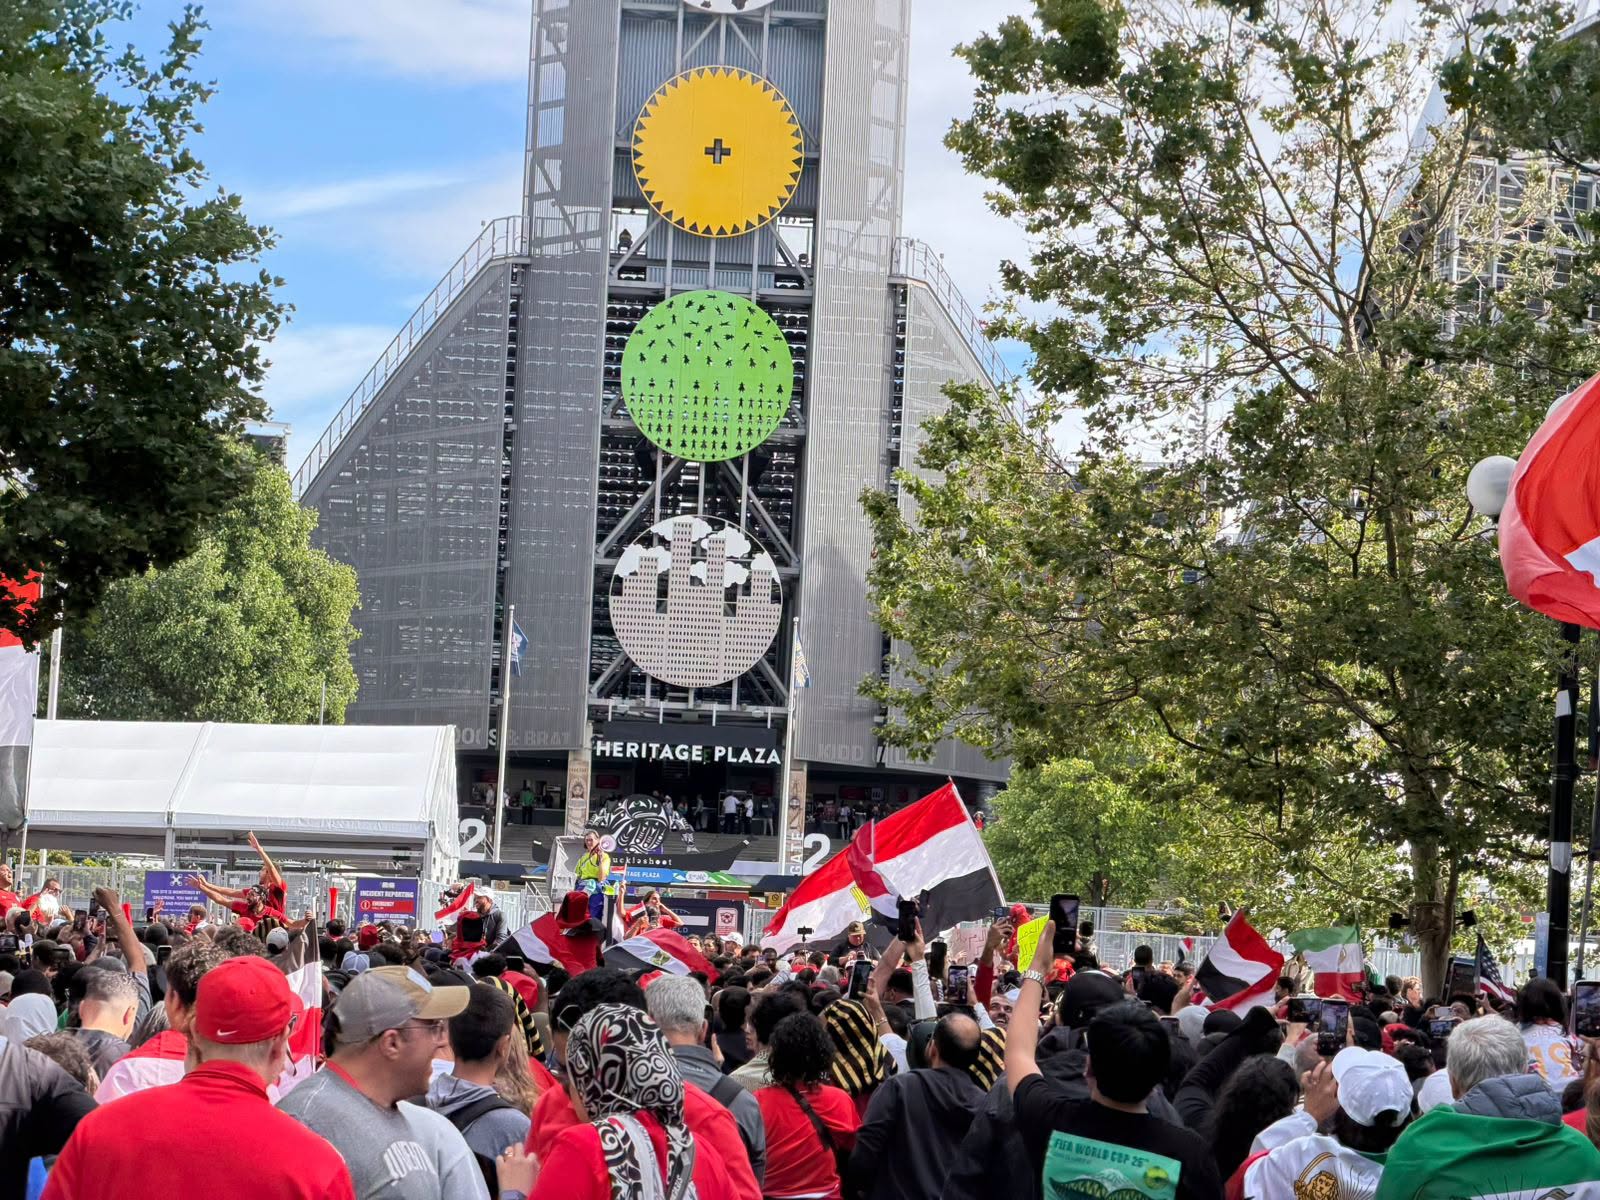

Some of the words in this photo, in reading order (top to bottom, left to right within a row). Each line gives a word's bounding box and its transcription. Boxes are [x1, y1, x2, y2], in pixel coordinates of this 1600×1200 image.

[596, 741, 703, 761] HERITAGE
[714, 746, 781, 764] PLAZA
[459, 818, 486, 861] 2
[790, 832, 804, 876] GATE
[803, 833, 830, 876] 2
[1529, 1042, 1573, 1078] 19
[1054, 1138, 1073, 1152] FIFA
[1075, 1142, 1108, 1160] WORLD
[1110, 1150, 1131, 1165] CUP
